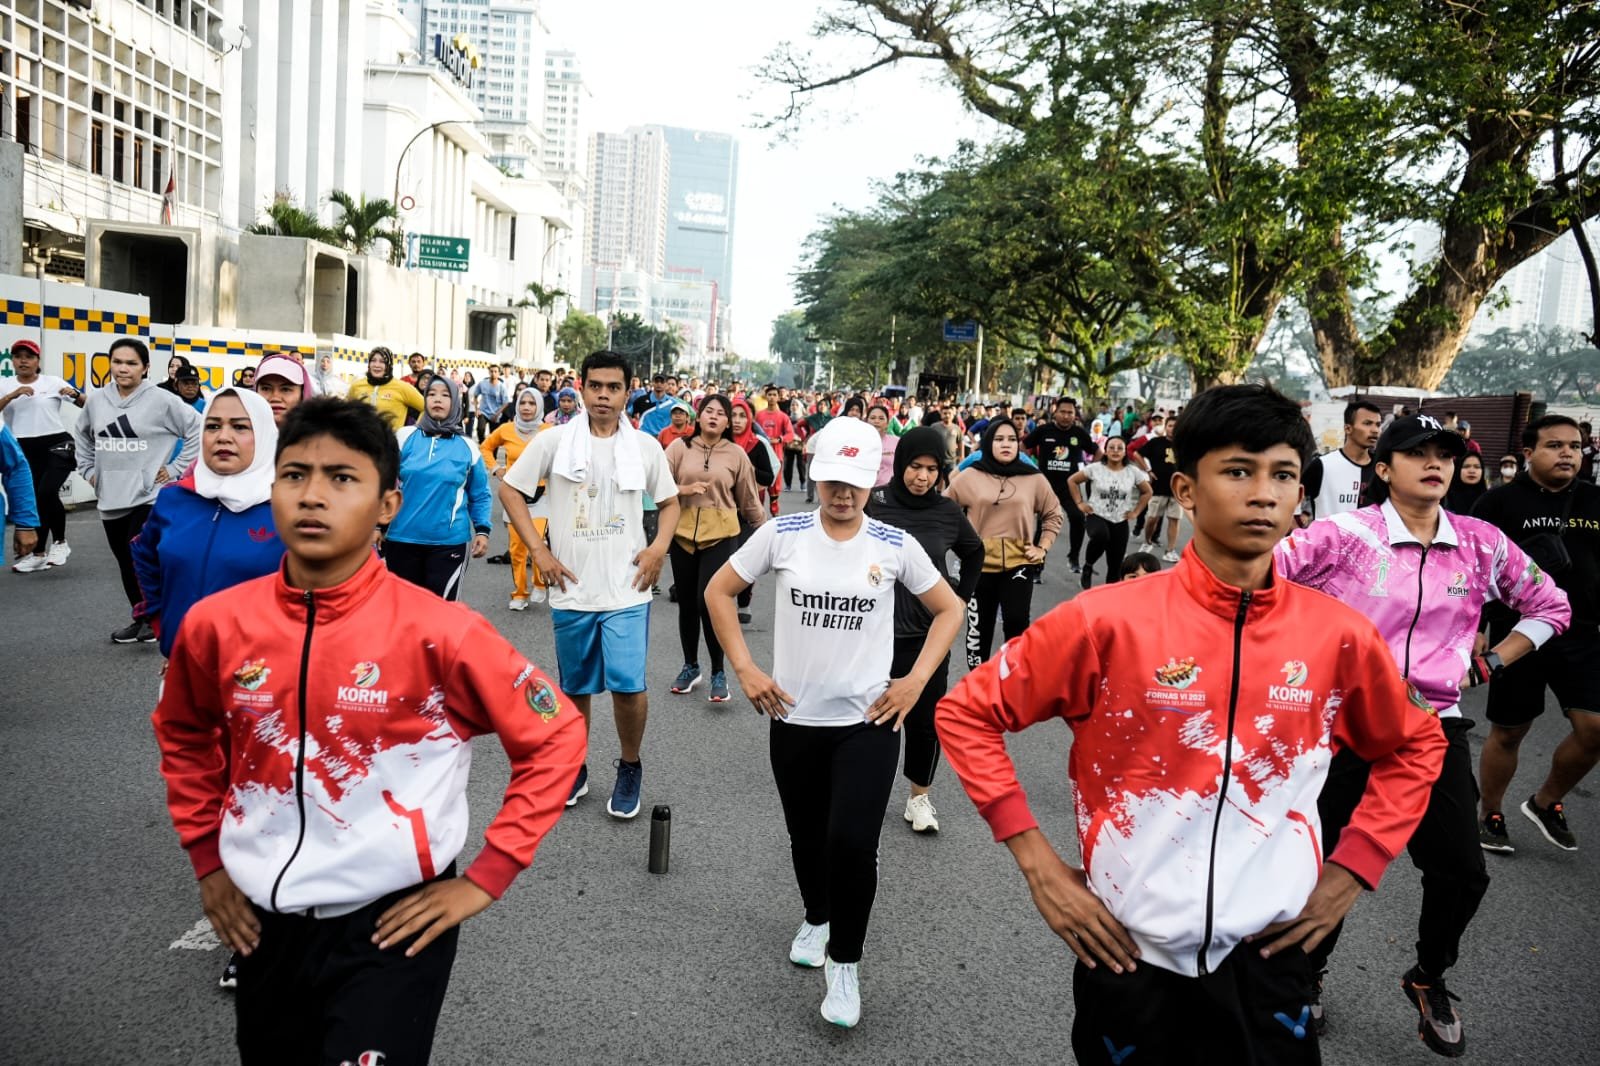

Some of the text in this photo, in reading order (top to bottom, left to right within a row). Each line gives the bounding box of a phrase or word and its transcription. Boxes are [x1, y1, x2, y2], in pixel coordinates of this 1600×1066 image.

[95, 438, 148, 452] adidas
[572, 530, 595, 538] UALA
[790, 587, 876, 612] Emirates
[801, 611, 863, 631] FLY BETTER
[337, 686, 388, 704] KORMI
[1146, 691, 1179, 700] FORNAS
[1269, 685, 1313, 704] KORMI
